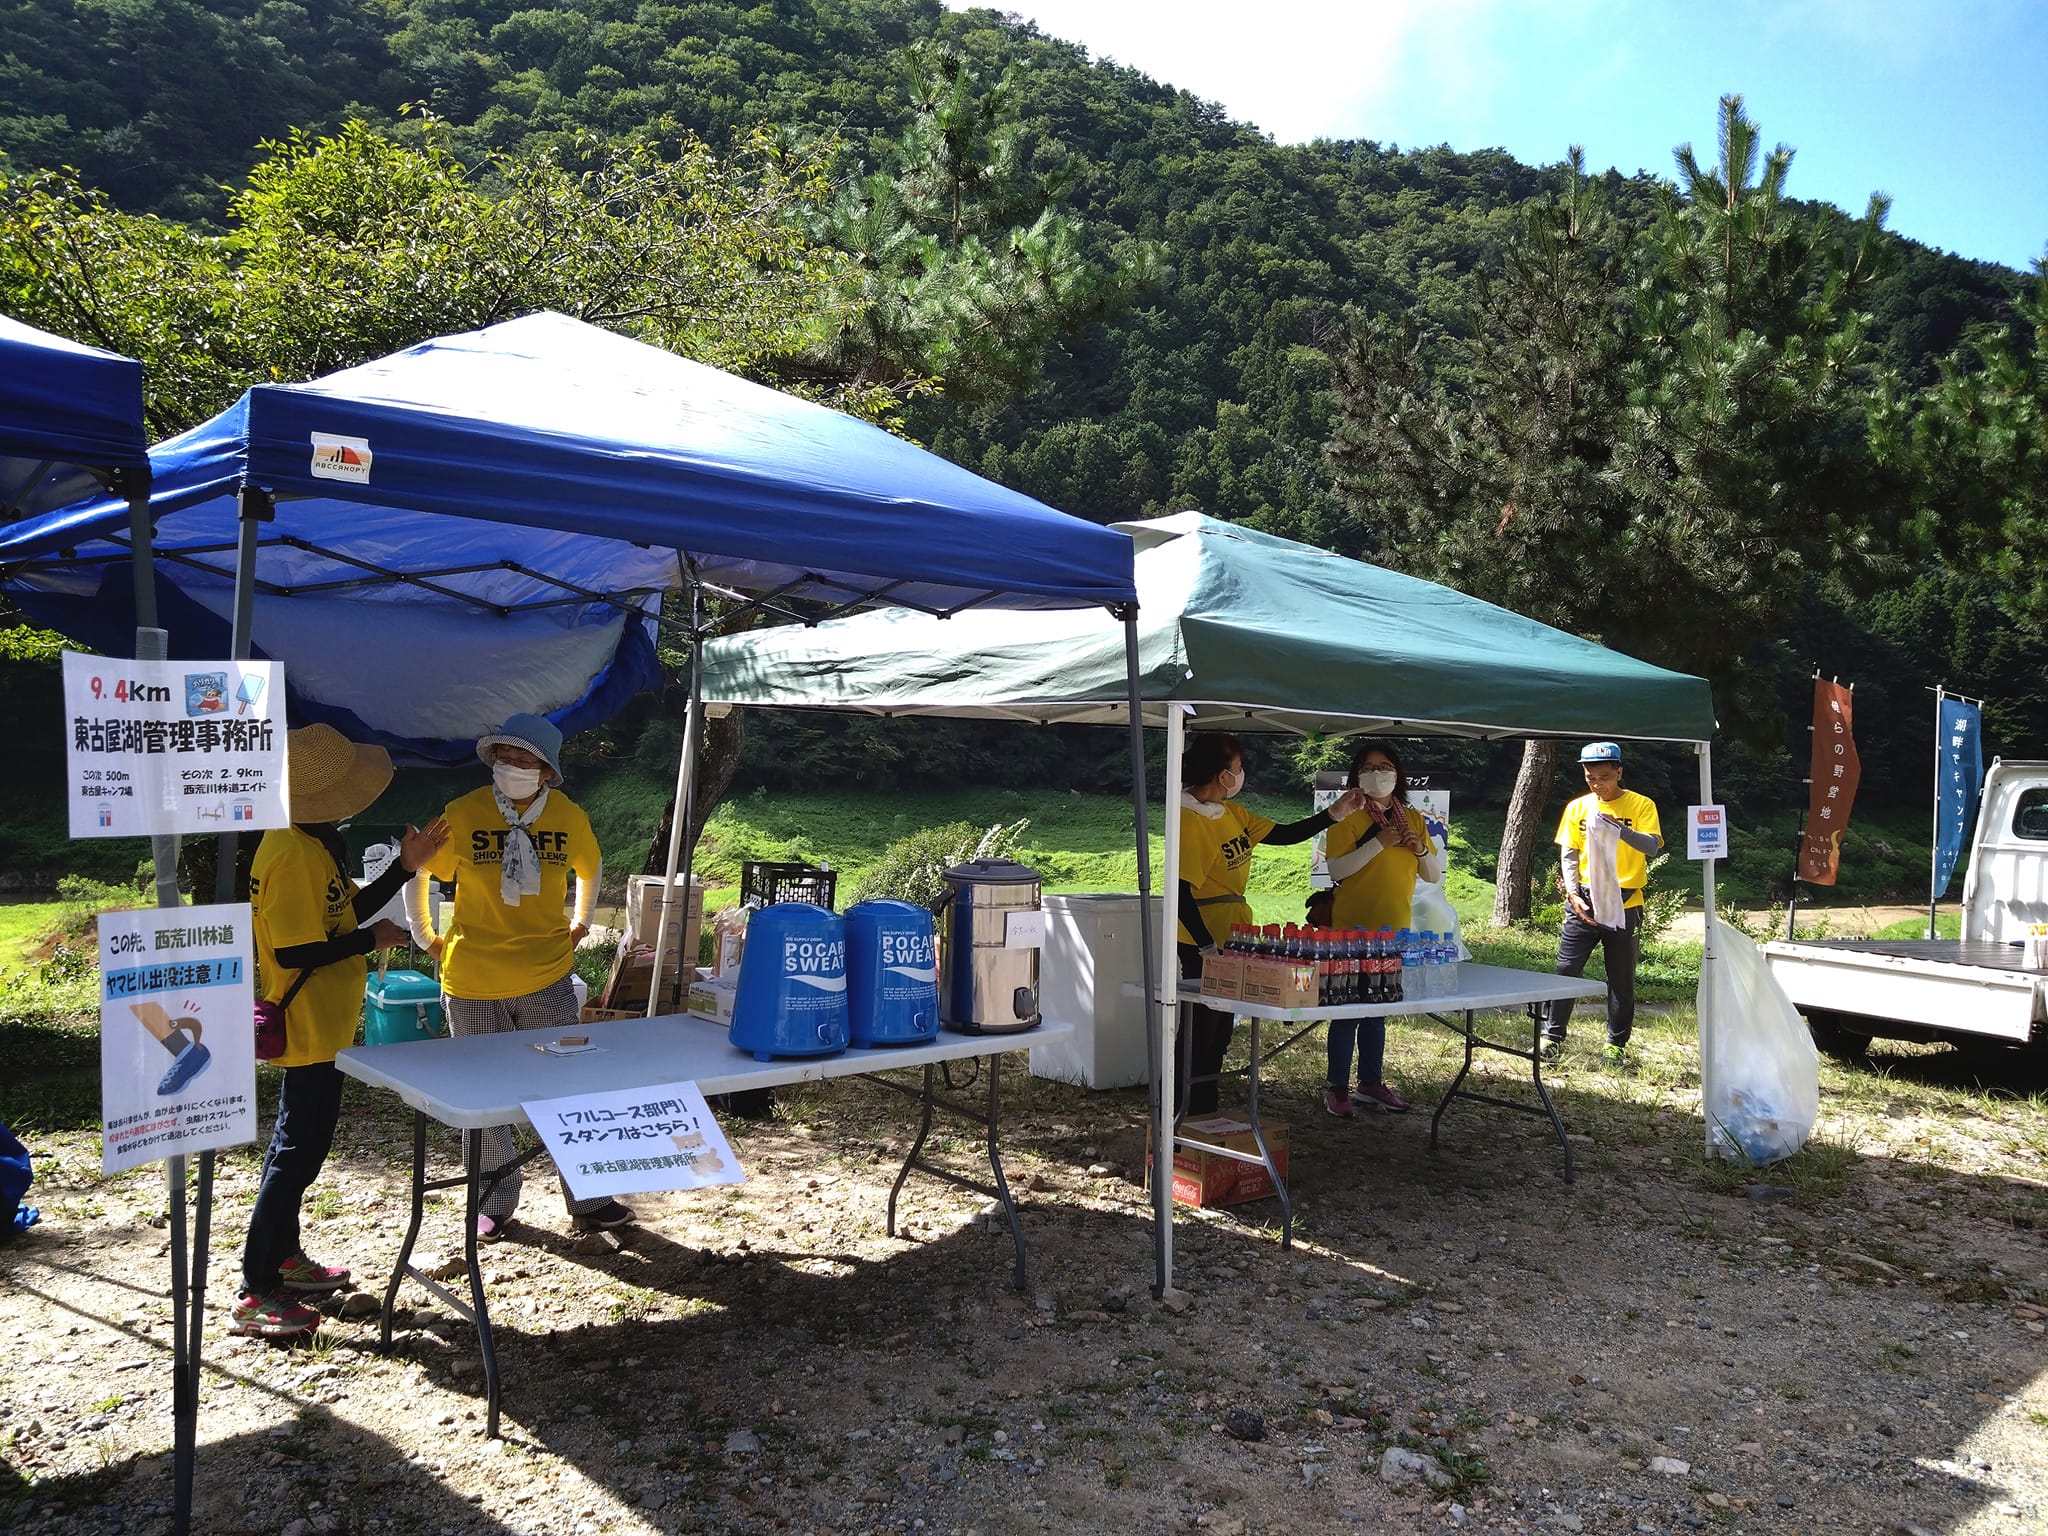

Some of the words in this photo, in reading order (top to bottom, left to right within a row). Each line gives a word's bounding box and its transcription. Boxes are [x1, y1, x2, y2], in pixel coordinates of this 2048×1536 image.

[315, 462, 366, 474] ABCCANOPY
[74, 716, 273, 754] 東古屋湖管理事務所
[82, 770, 102, 782] この次
[106, 770, 130, 782] 500m
[180, 769, 214, 780] その次
[81, 785, 134, 797] 東古屋キャンプ場
[183, 782, 267, 795] 西荒川林道エイド
[472, 829, 568, 851] STFF
[473, 851, 504, 861] SHIOY
[785, 956, 845, 972] SWEAT
